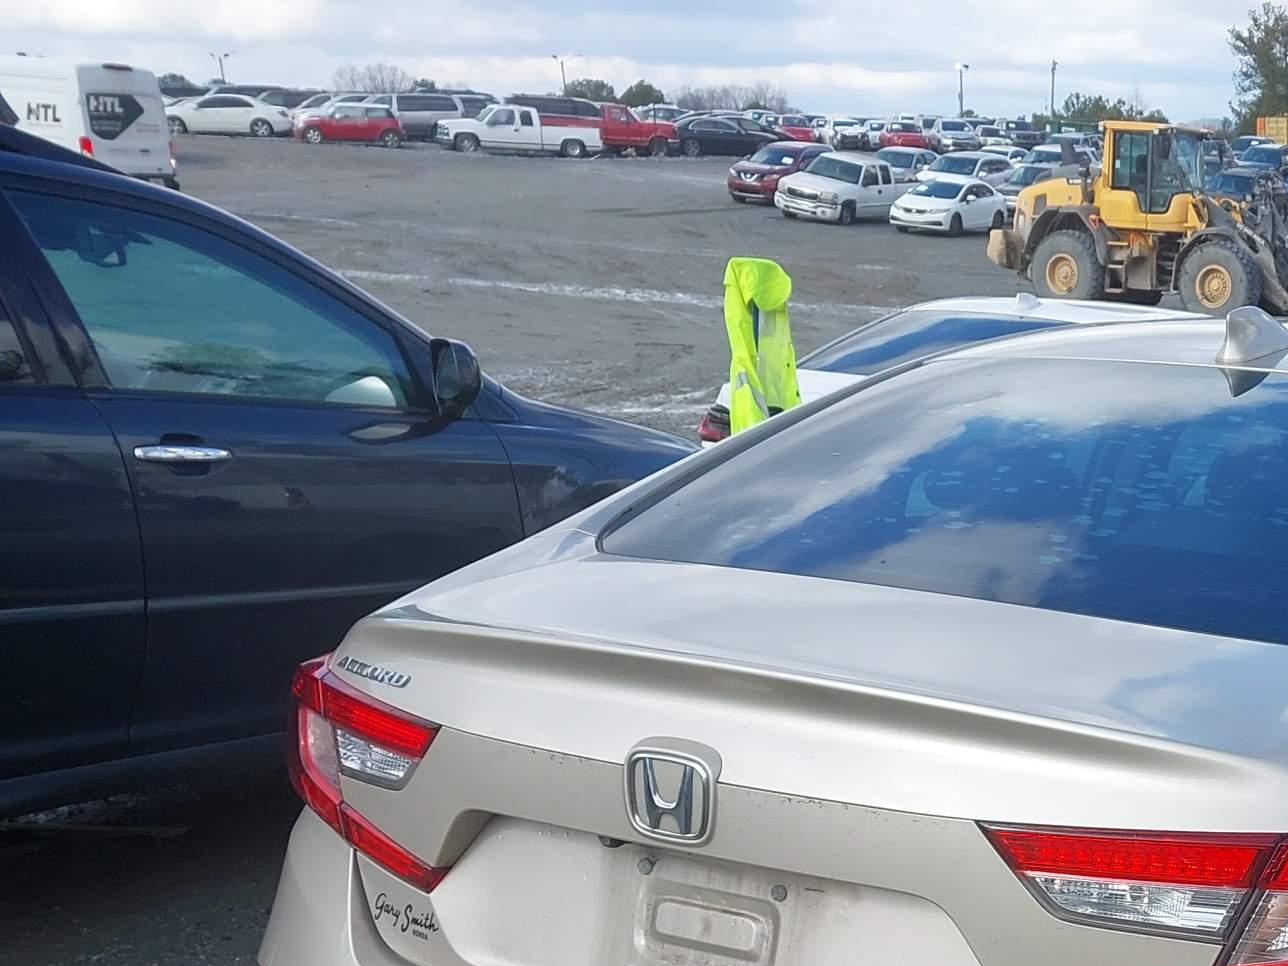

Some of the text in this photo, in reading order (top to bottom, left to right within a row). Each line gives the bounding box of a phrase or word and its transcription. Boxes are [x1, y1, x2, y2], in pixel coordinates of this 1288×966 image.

[337, 655, 412, 688] ACCORD
[374, 892, 439, 933] Gary Smith
